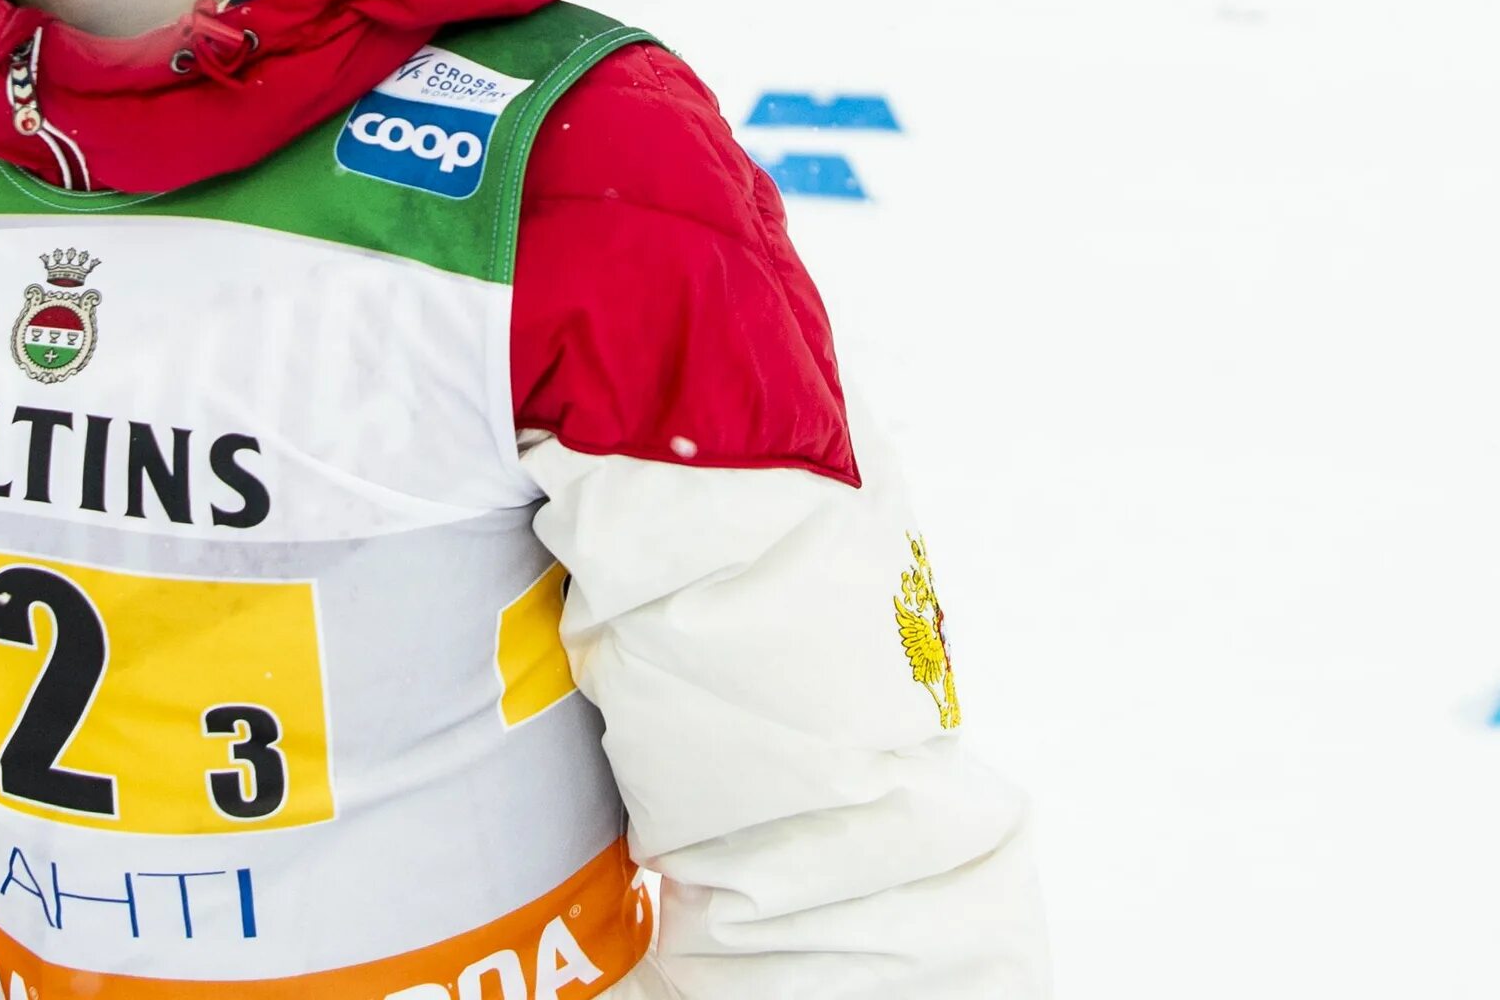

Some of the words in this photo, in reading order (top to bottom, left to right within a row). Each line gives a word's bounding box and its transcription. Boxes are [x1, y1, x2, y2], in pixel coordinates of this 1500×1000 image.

[426, 75, 509, 99] COUNTRY
[434, 62, 497, 91] CROSS
[351, 112, 483, 173] coop
[204, 705, 286, 819] 3
